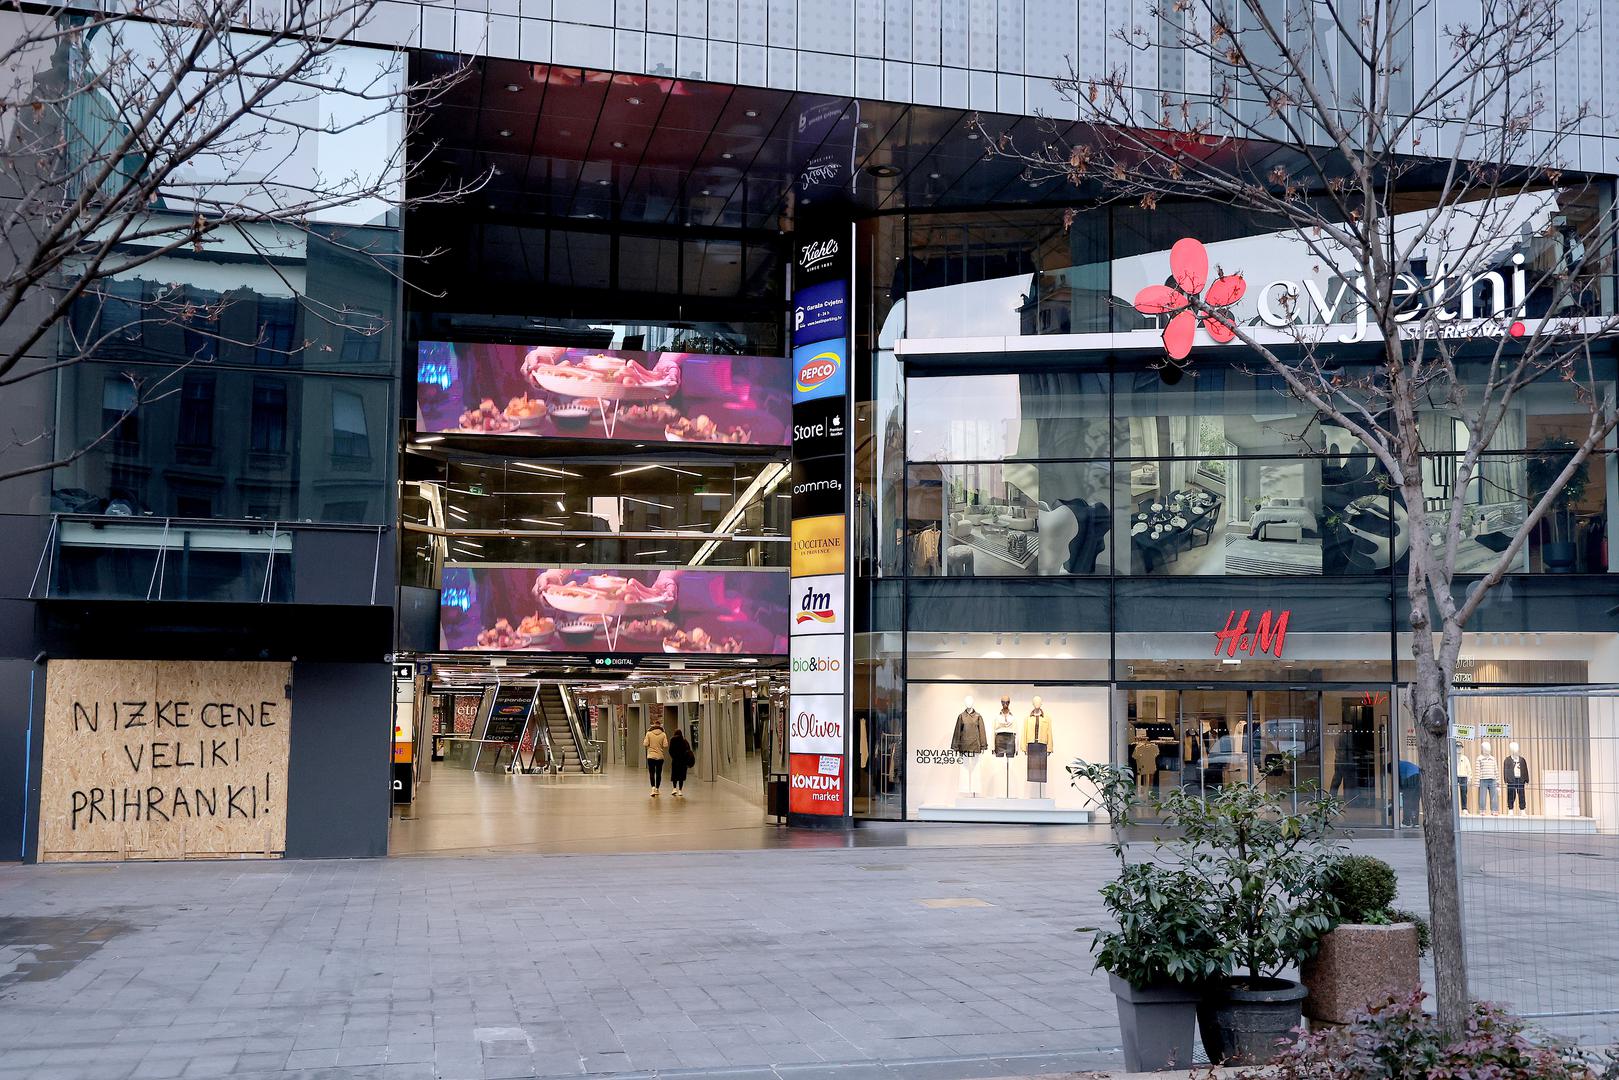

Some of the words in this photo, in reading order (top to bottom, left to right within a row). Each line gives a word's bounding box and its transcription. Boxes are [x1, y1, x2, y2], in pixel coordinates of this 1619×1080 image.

[799, 239, 838, 265] Kiehl's
[801, 363, 833, 381] PEPCO
[793, 423, 824, 441] Store
[793, 479, 842, 494] comma,
[793, 537, 841, 551] L'OCCITANE
[806, 548, 830, 556] PROVENCE
[802, 586, 831, 611] dm
[1214, 609, 1292, 658] H&M
[792, 656, 840, 672] bio&bio
[73, 700, 189, 732] NIZKE
[201, 701, 276, 728] CENE
[791, 711, 842, 738] s.Oliver
[124, 737, 239, 772] VELIKI
[932, 757, 955, 765] 12,99
[791, 774, 840, 791] KONZUM
[72, 772, 269, 830] PRIHRANKI!
[812, 791, 840, 802] market
